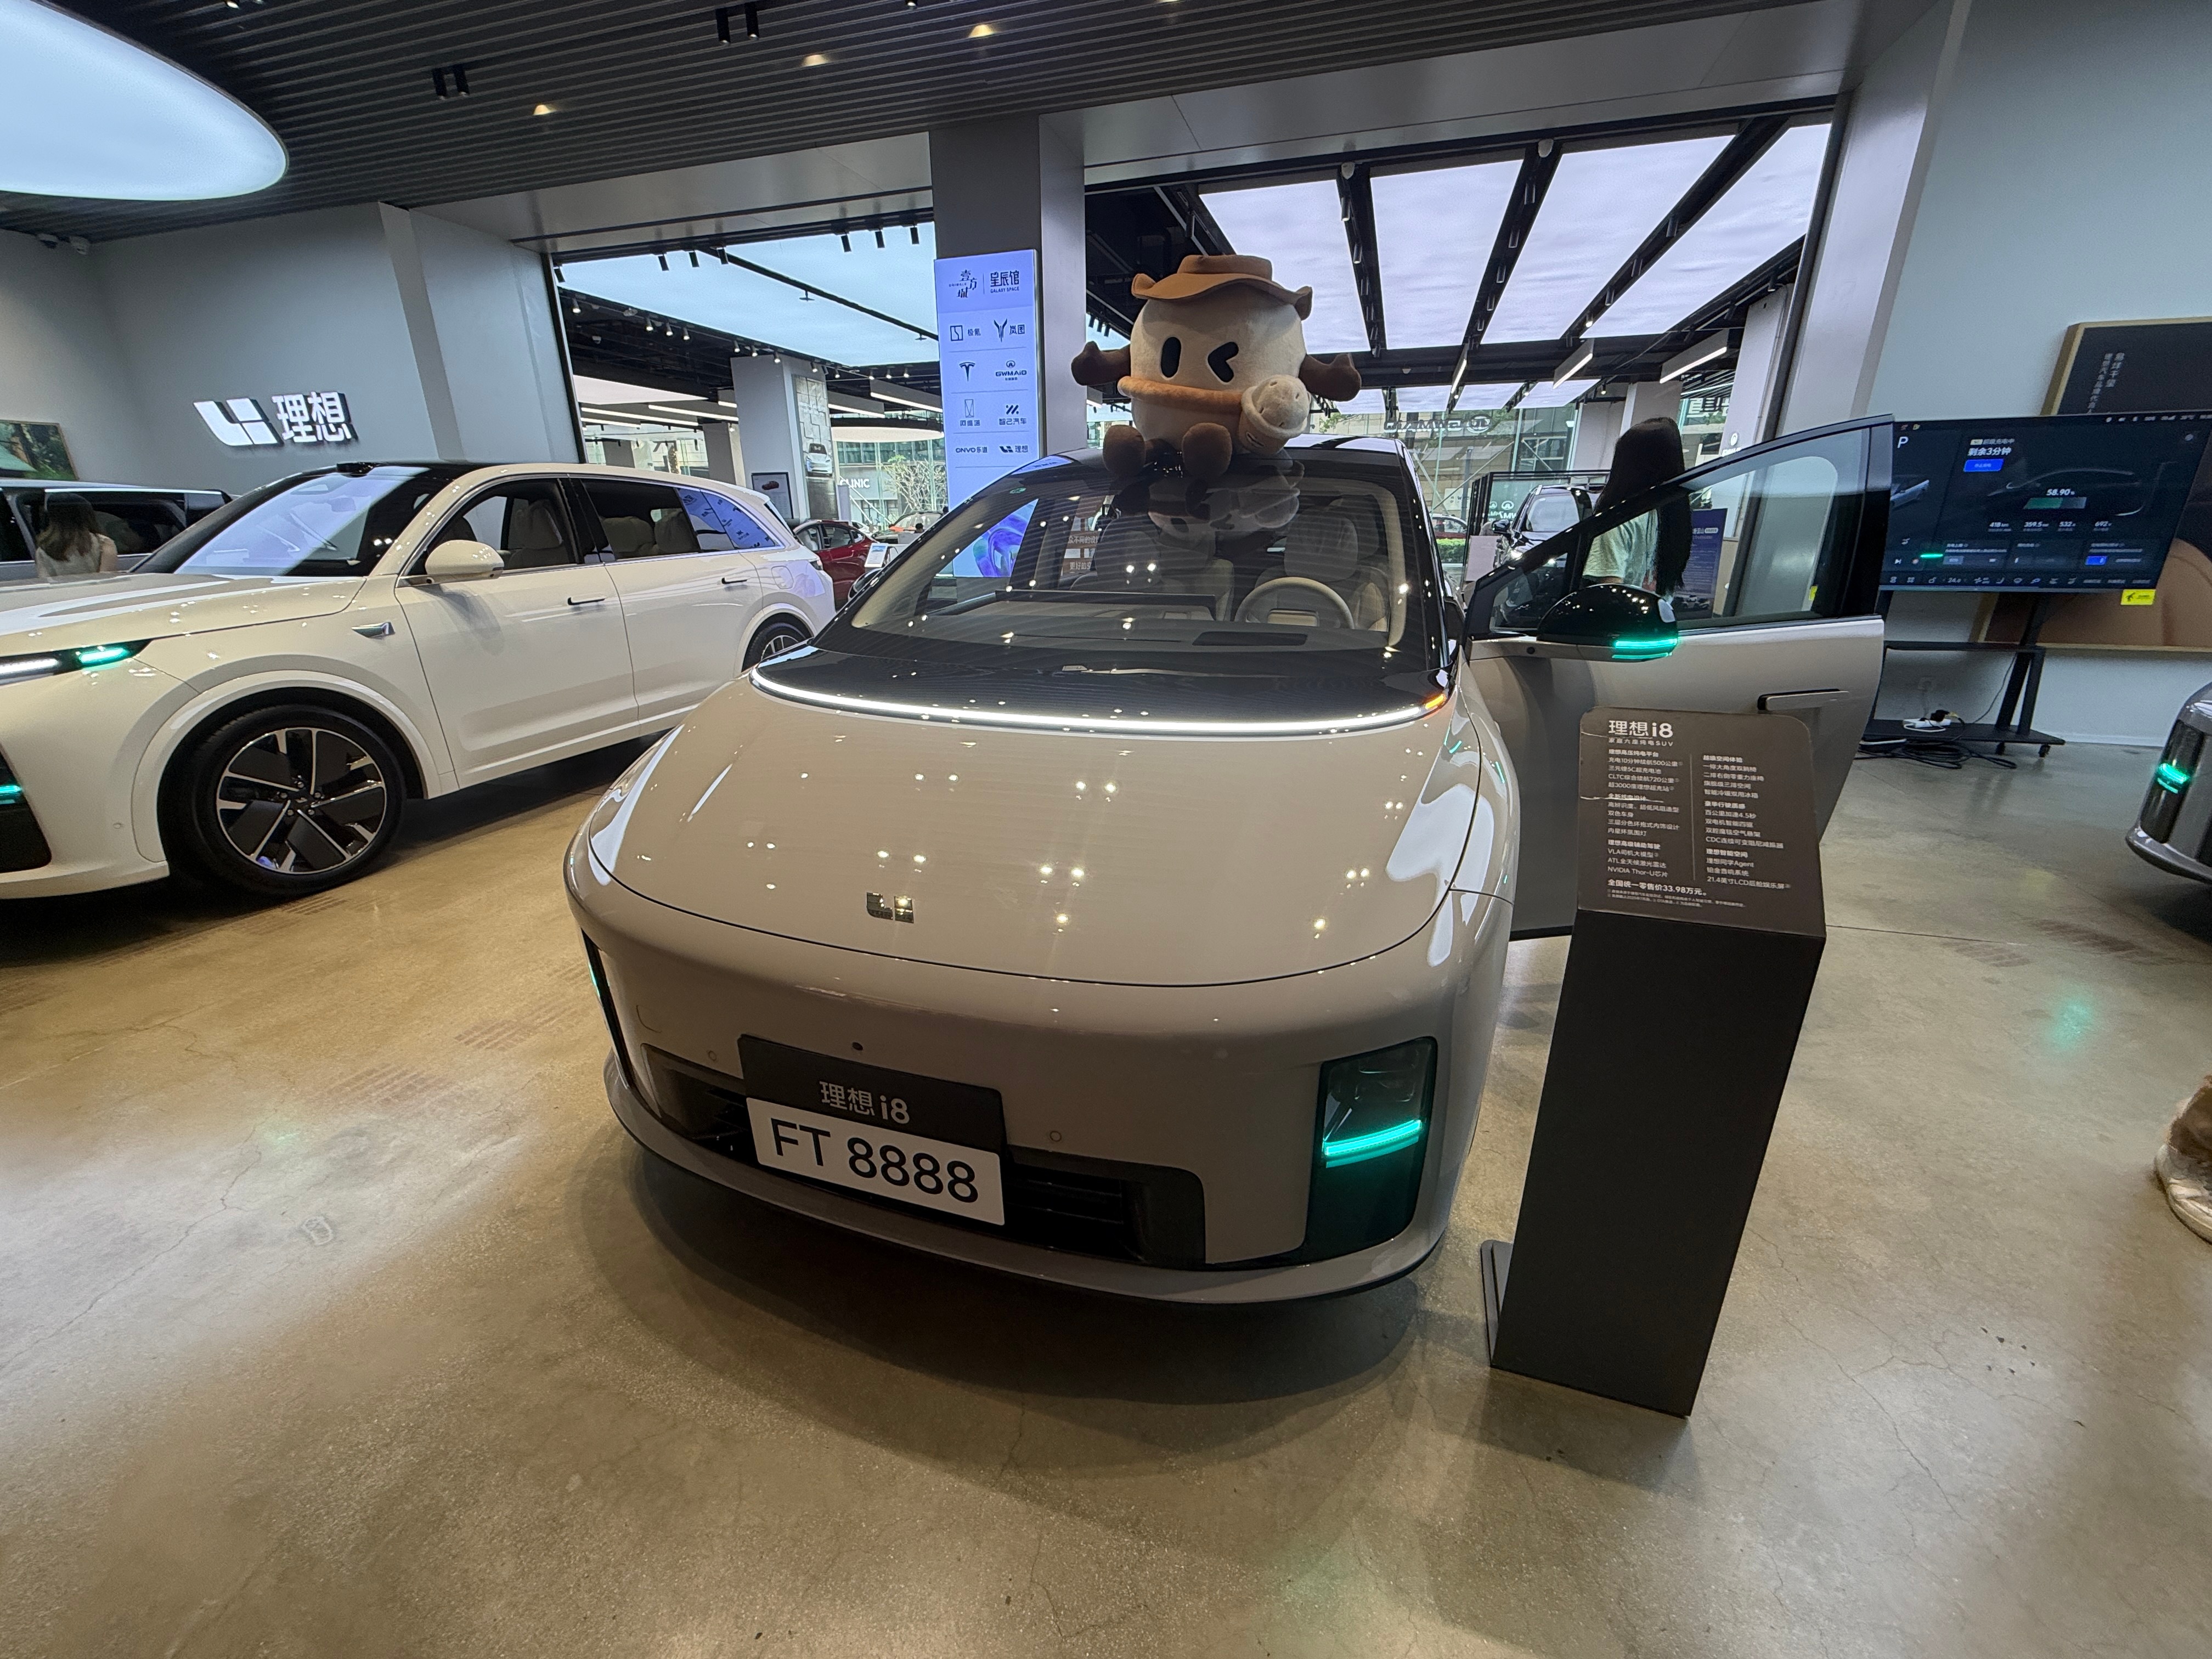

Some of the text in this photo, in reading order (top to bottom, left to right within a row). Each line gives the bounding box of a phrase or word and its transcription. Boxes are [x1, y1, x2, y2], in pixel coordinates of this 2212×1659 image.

[990, 269, 1019, 287] 星辰馆
[967, 328, 981, 336] 极氪
[1009, 324, 1025, 335] 岚图
[272, 391, 353, 443] 理想
[1897, 436, 1909, 448] P
[1967, 447, 2012, 456] 剩余3分钟
[1607, 810, 1634, 818] 双色车身
[770, 1118, 979, 1203] FT 8888
